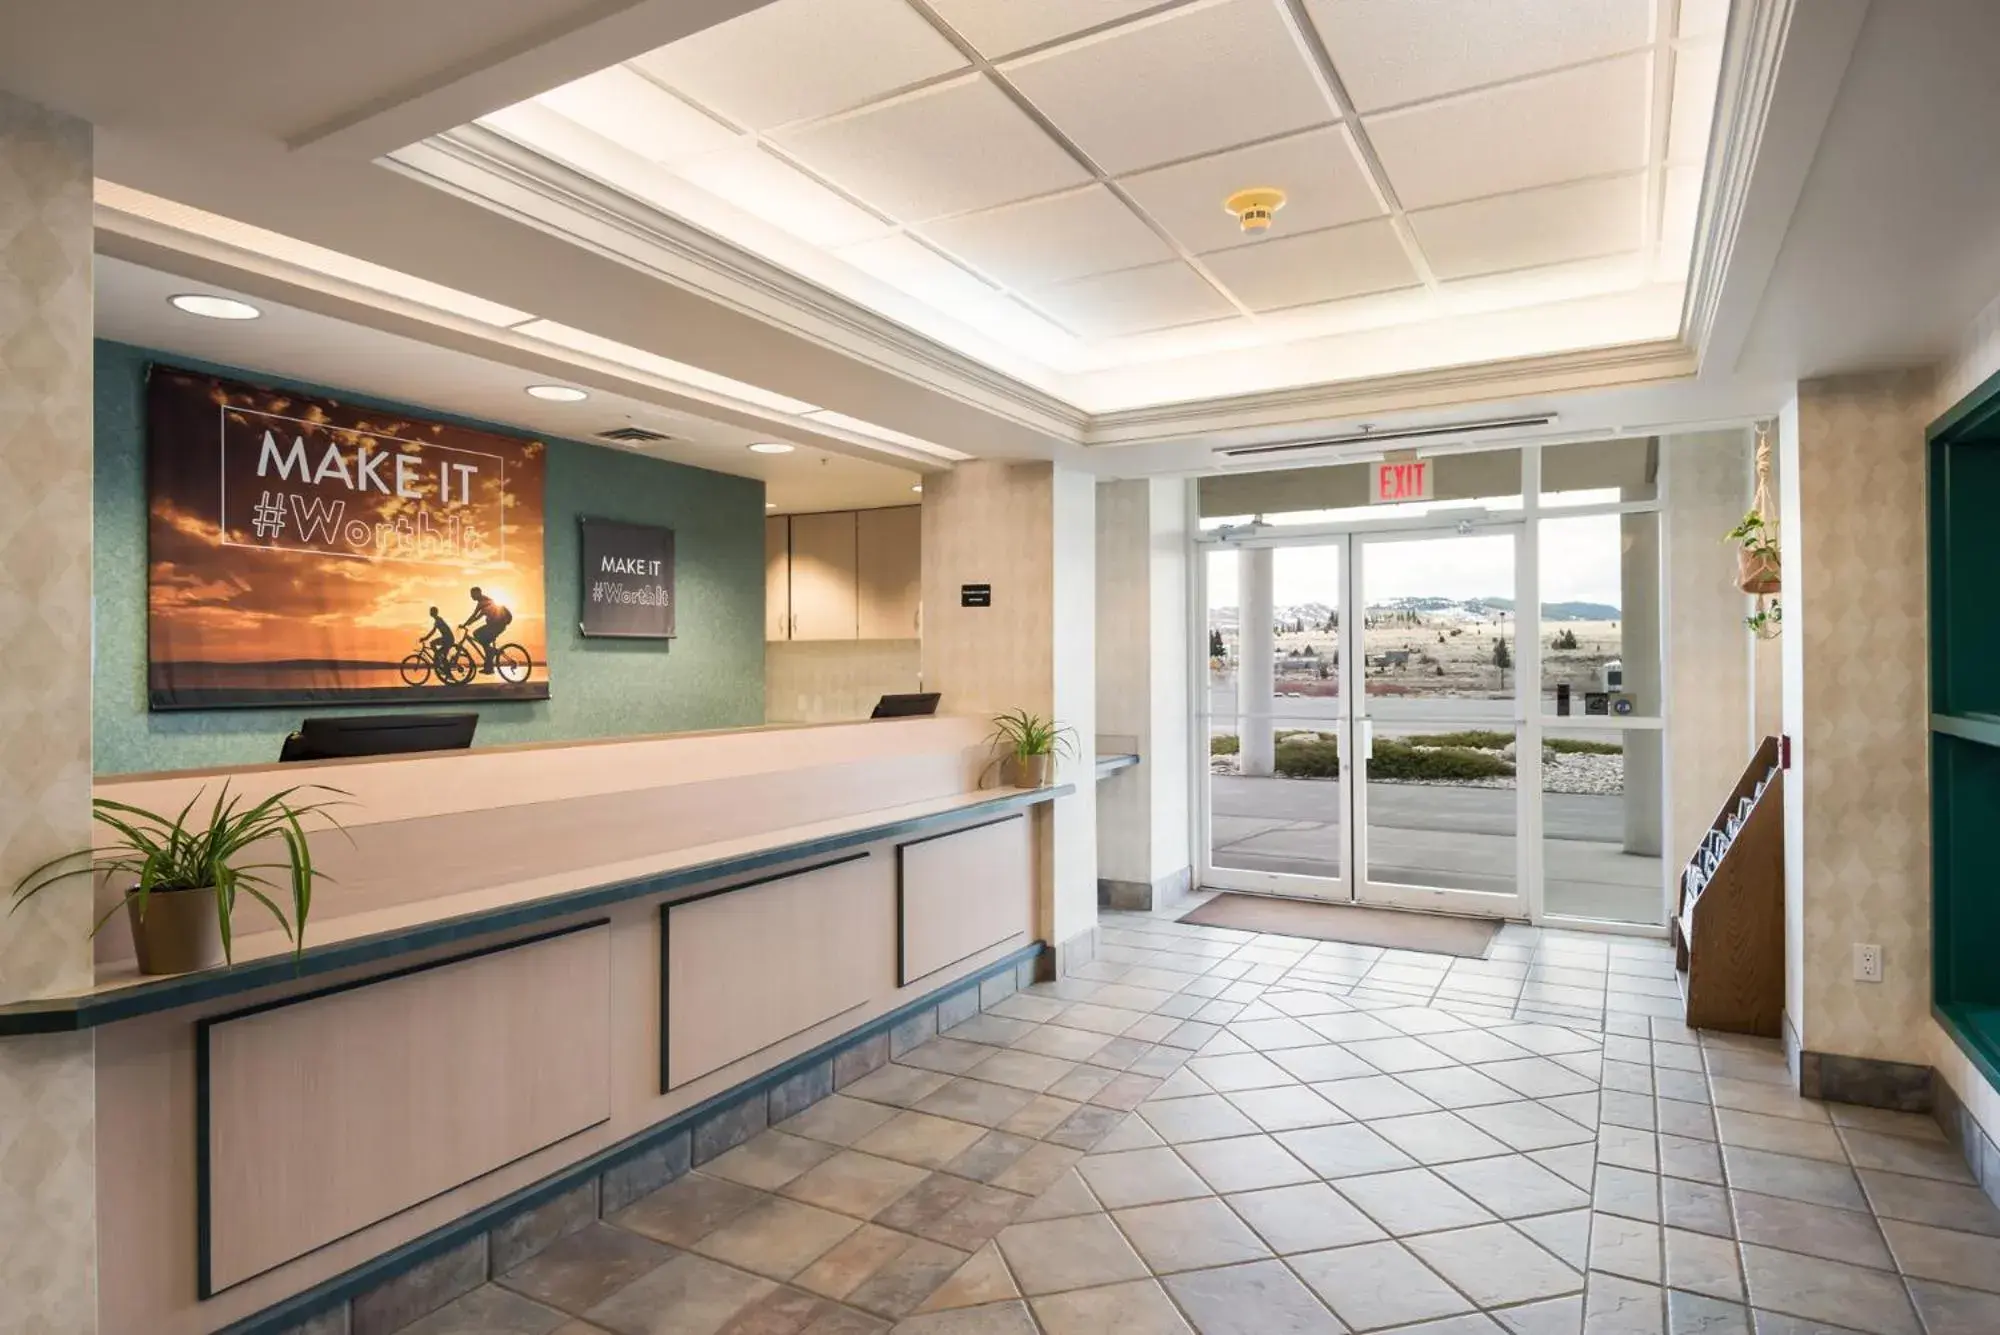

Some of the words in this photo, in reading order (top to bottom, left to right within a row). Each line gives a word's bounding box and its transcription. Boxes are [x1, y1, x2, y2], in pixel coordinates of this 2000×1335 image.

[257, 430, 423, 500] MAKE
[441, 461, 479, 505] IT
[1380, 463, 1426, 500] EXIT
[252, 490, 484, 559] #WorthIt
[601, 555, 646, 576] MAKE
[648, 560, 662, 577] IT
[592, 581, 670, 607] #WorthIt
